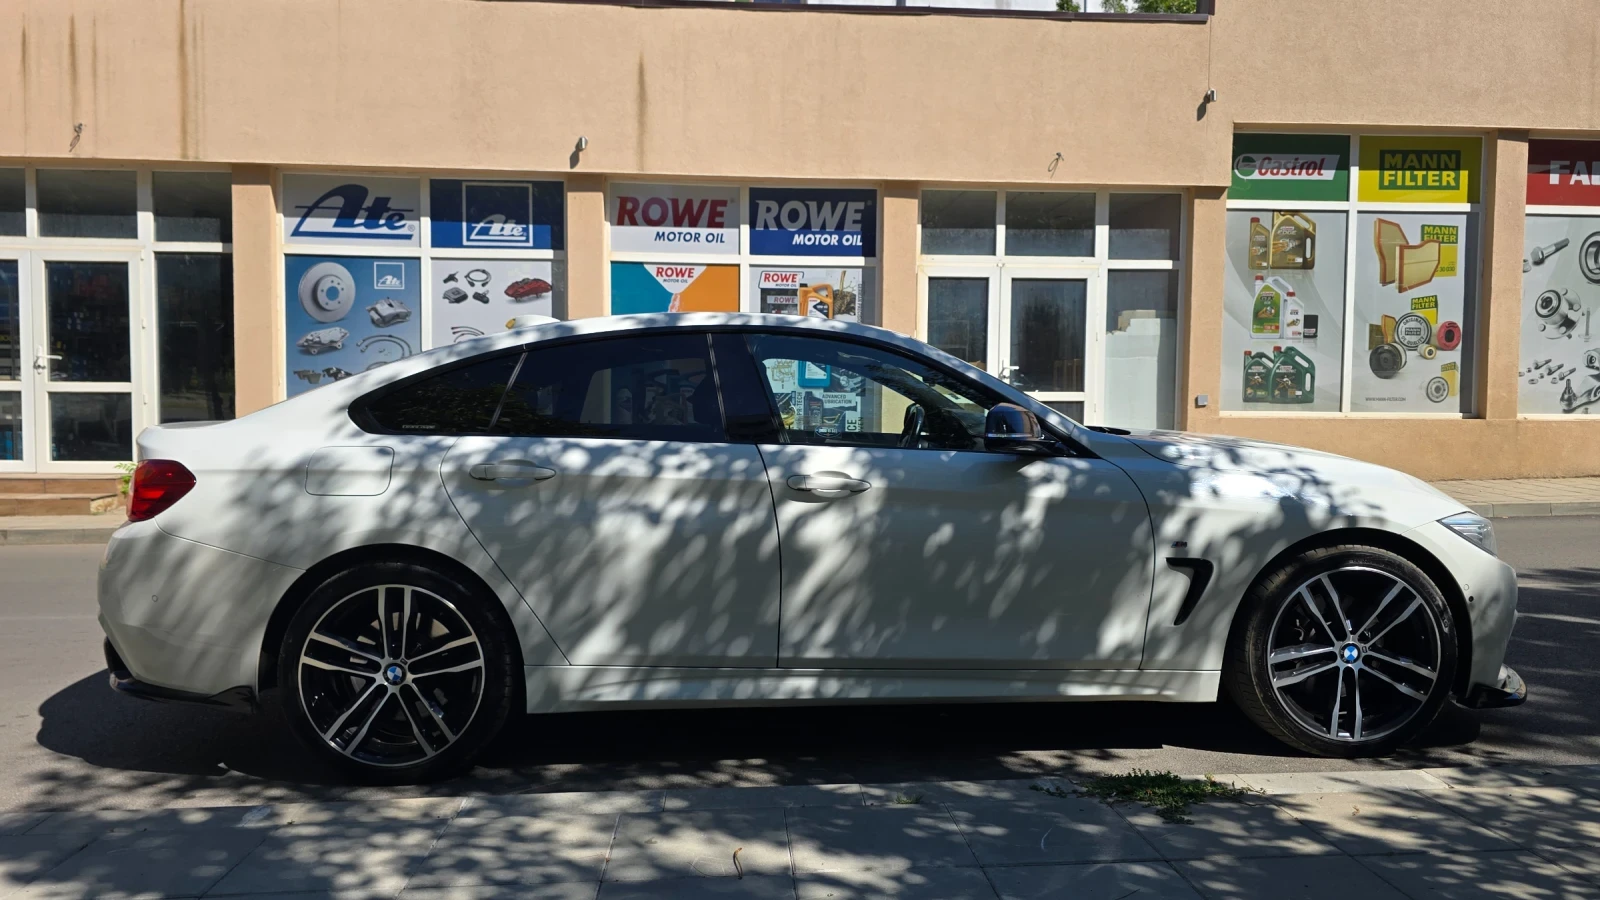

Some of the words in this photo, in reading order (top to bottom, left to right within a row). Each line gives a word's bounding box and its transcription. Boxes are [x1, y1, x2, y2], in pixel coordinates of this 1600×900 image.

[1258, 156, 1326, 176] Castrol
[1384, 153, 1456, 169] MANN
[1383, 170, 1456, 186] FILTER
[616, 196, 728, 229] ROWE
[755, 200, 865, 231] ROWE
[1424, 226, 1457, 234] MANN
[654, 231, 701, 243] MOTOR
[705, 232, 725, 243] OIL
[792, 234, 838, 246] MOTOR
[842, 234, 863, 246] OIL
[1424, 234, 1457, 243] FILTER
[656, 266, 695, 278] ROWE
[763, 273, 798, 283] ROWE
[1412, 296, 1436, 304] MANN
[1406, 335, 1425, 345] QUALITY
